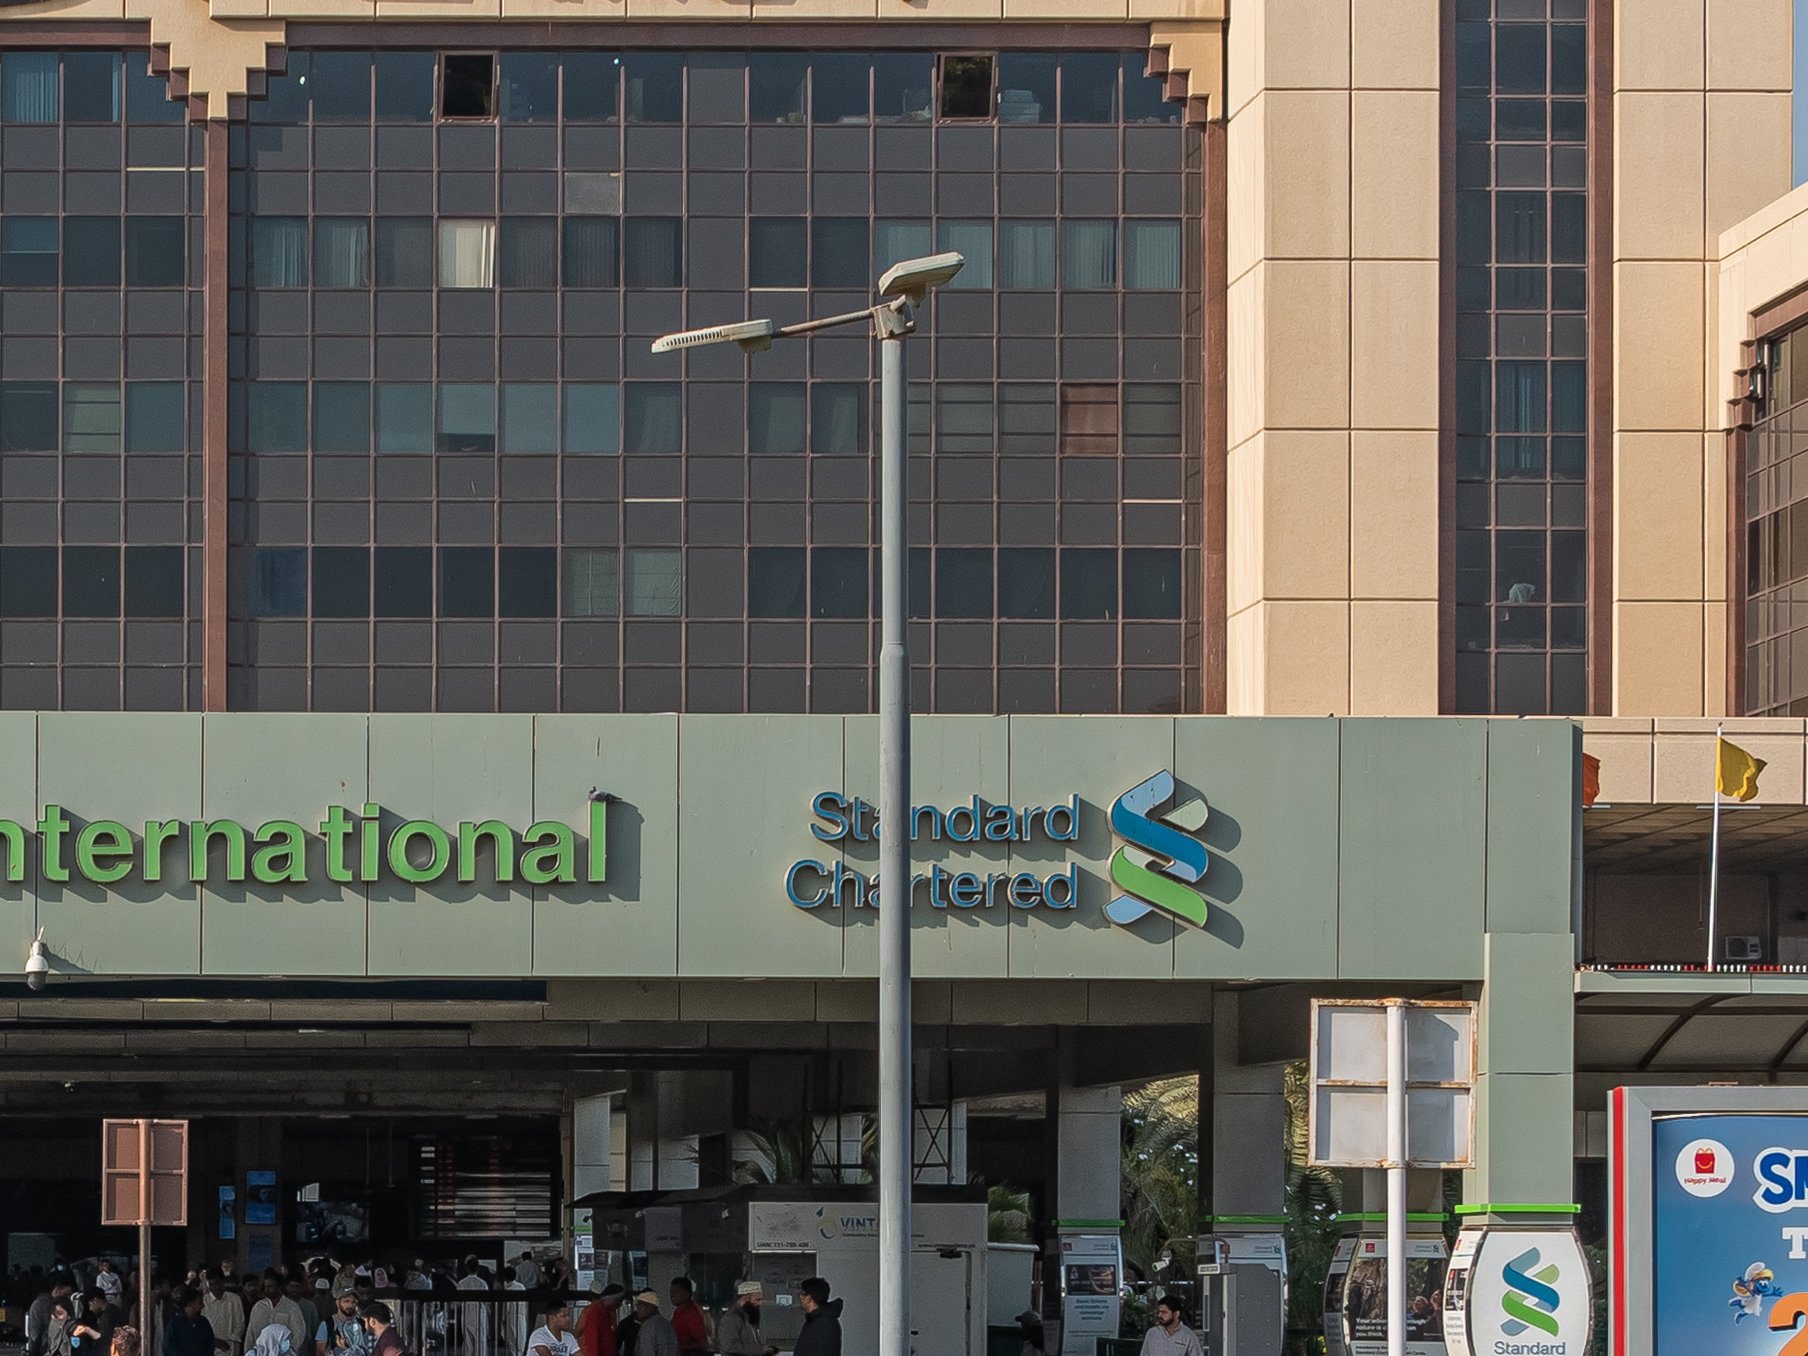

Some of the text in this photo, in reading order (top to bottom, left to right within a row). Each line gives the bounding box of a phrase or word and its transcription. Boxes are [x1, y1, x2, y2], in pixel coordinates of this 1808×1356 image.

[809, 791, 1080, 843] Stndard
[839, 1217, 881, 1229] VINT
[1493, 1341, 1566, 1356] Standard
